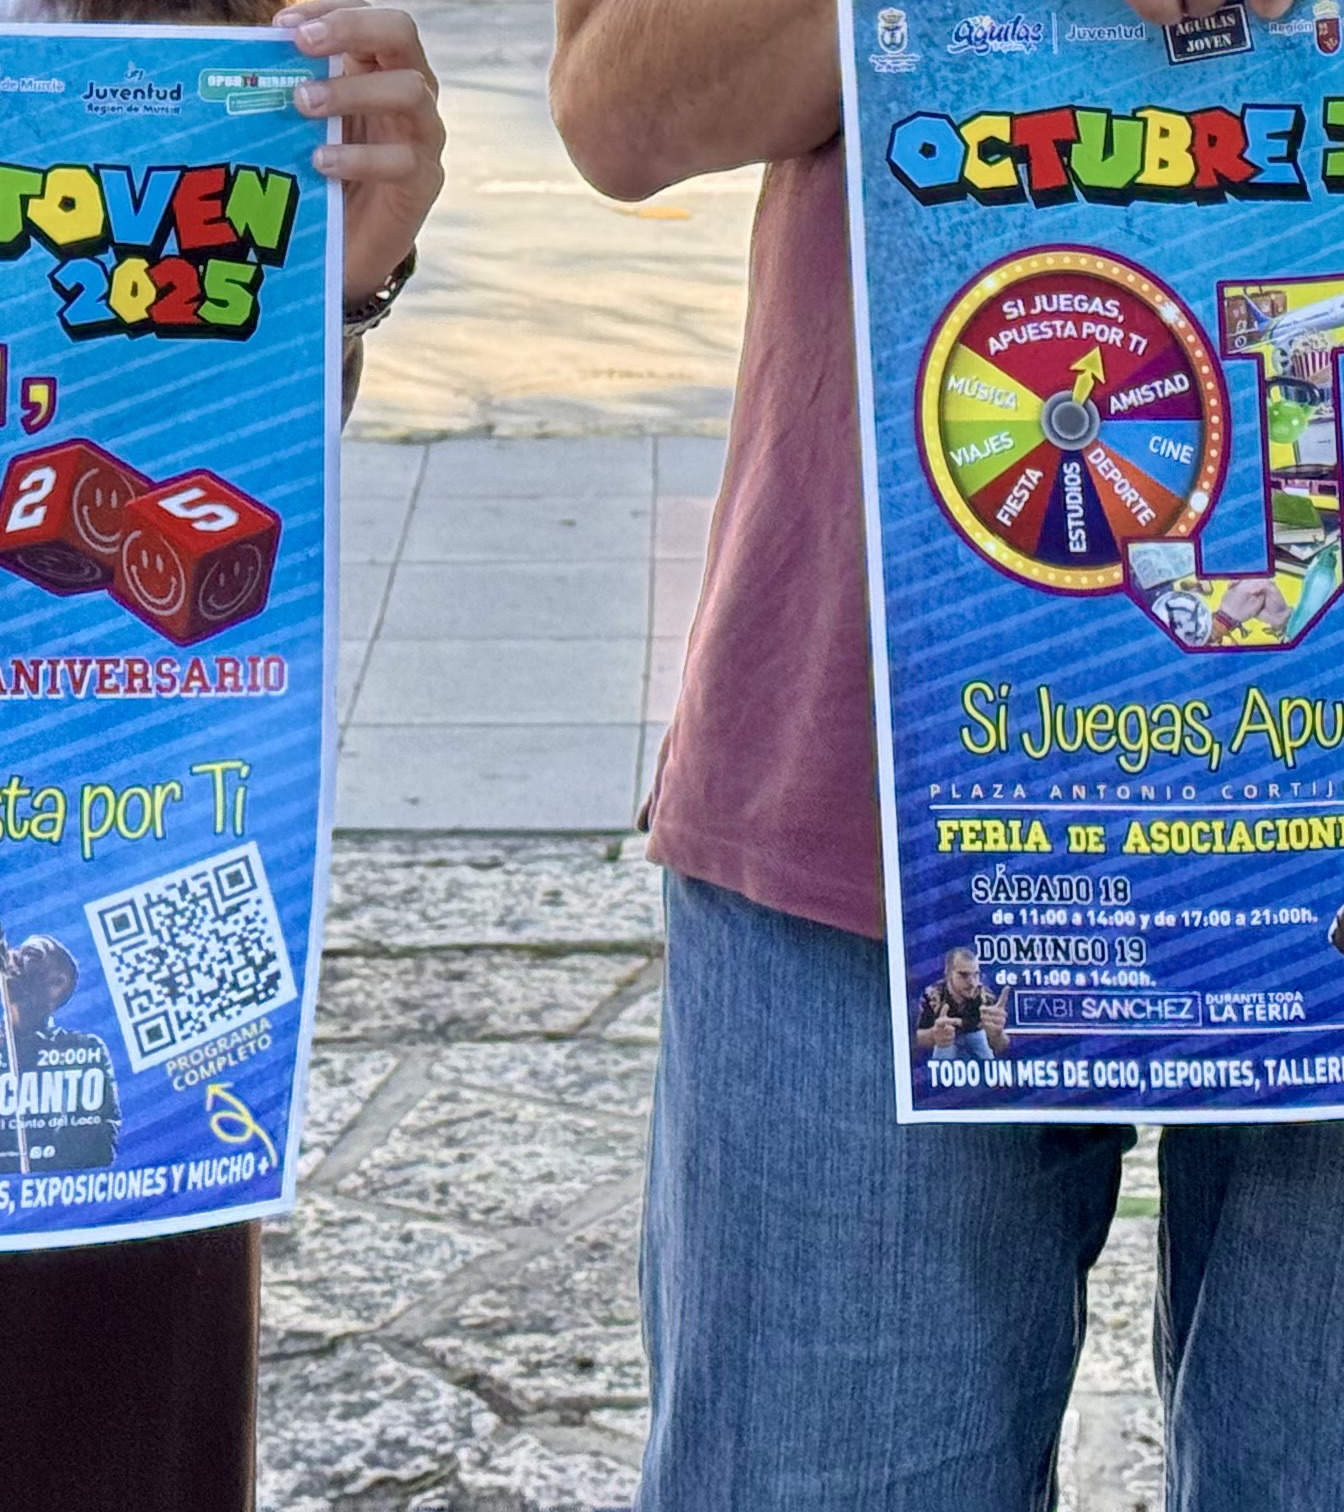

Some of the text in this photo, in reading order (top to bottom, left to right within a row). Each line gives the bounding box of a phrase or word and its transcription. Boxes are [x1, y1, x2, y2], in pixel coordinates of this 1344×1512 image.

[1067, 24, 1146, 41] Juventud
[1186, 34, 1231, 53] JOVEN
[82, 81, 182, 101] Juventud
[885, 104, 1312, 209] OCTUBRE
[48, 256, 264, 342] 2025
[1002, 294, 1125, 322] SI JUEGAS,
[987, 319, 1148, 356] APUESTA POR TI
[947, 374, 1018, 411] MÚSICA
[1109, 373, 1190, 414] AMISTAD
[949, 431, 1014, 467] VIAJES
[1149, 435, 1194, 465] CINE
[5, 465, 239, 533] 2 5
[996, 466, 1044, 527] FIESTA
[1086, 447, 1156, 527] DEPORTE
[1063, 462, 1087, 553] ESTUDIOS
[961, 680, 1010, 755] Si
[1021, 685, 1222, 774] Juegas,
[79, 780, 182, 861] por
[189, 757, 252, 836] Ti
[929, 783, 1027, 799] PLAZA
[1050, 785, 1197, 801] ANTONIO
[936, 818, 1052, 854] FERIA
[1067, 825, 1106, 854] DE
[971, 862, 1131, 906] SÁBADO 18
[992, 908, 1318, 931] de 11:00 a 14:00 y de 17:00 a 21:00h.
[974, 935, 1147, 967] DOMINGO 19
[995, 969, 1157, 987] de 11:00 a 14:00h.
[1023, 997, 1194, 1020] FABI SANCHEZ
[1205, 991, 1304, 1005] DURANTE TODA
[1210, 1003, 1306, 1023] LA FERIA
[37, 1047, 101, 1066] 20:00H
[166, 1021, 272, 1077] PROGRAMA
[172, 1033, 273, 1092] COMPLETO
[927, 1061, 980, 1088] TODO
[984, 1060, 1014, 1088] UN
[1017, 1060, 1059, 1088] MES
[1063, 1060, 1090, 1087] DE
[1094, 1060, 1145, 1095] OCIO,
[1150, 1060, 1260, 1092] DEPORTES,
[20, 1166, 166, 1209] EXPOSICIONES
[171, 1164, 186, 1192] Y
[187, 1157, 255, 1191] MUCHO
